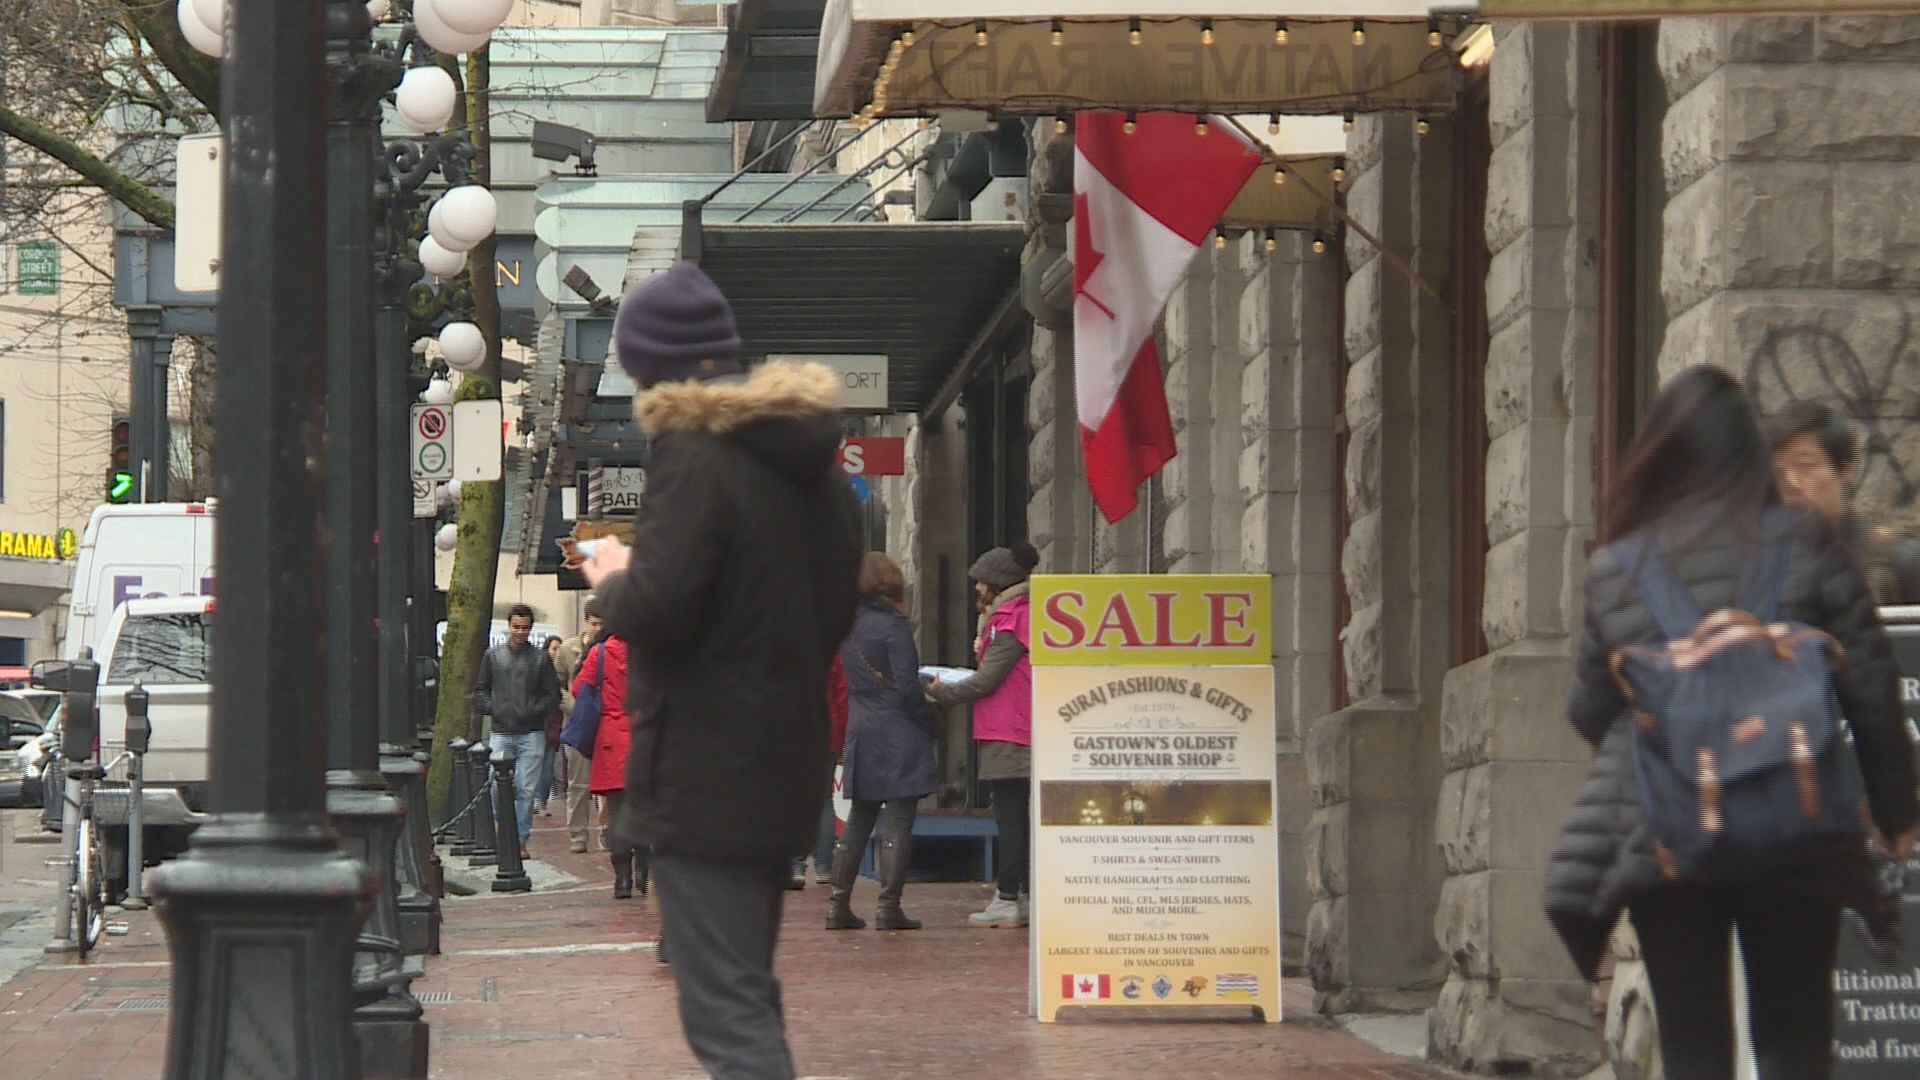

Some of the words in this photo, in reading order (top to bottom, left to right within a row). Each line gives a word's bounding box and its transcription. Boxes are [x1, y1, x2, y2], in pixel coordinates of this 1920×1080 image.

[20, 262, 52, 274] STREET
[838, 371, 881, 389] ORT
[1042, 591, 1256, 648] SALE
[1058, 686, 1107, 723] SURAJ
[1107, 675, 1187, 699] FASHIONS
[1190, 682, 1202, 699] &
[1206, 687, 1253, 722] GIFTS
[1073, 736, 1170, 750] GASTOWN'S
[1173, 736, 1237, 750] OLDEST
[1089, 752, 1174, 767] SOUVENIR
[1177, 752, 1222, 767] SHOP
[1060, 835, 1119, 844] VANCOUVER
[1121, 835, 1172, 844] SOUVENIR
[1174, 835, 1196, 844] AND
[1198, 835, 1220, 844] GIFT
[1223, 835, 1255, 844] ITEMS
[1092, 855, 1136, 864] T-SHIRTS
[1138, 855, 1146, 864] &
[1148, 855, 1221, 864] SWEAT-SHIRTS
[1064, 875, 1101, 885] NATIVE
[1103, 875, 1174, 885] HANDICRAFTS
[1176, 875, 1197, 885] AND
[1199, 875, 1251, 885] CLOTHING
[1064, 896, 1109, 905] OFFICIAL
[1159, 896, 1180, 905] MLS
[1182, 896, 1222, 906] JERSIES,
[1224, 896, 1252, 906] HATS,
[1112, 906, 1133, 915] AND
[1136, 906, 1165, 915] MUCH
[1108, 933, 1131, 942] BEST
[1134, 933, 1165, 942] DEALS
[1167, 933, 1178, 942] IN
[1180, 933, 1209, 942] TOWN
[1048, 946, 1091, 956] LARGEST
[1093, 946, 1146, 956] SELECTION
[1148, 946, 1161, 956] OF
[1163, 946, 1217, 956] SOUVENIRS
[1219, 946, 1240, 956] AND
[1242, 946, 1269, 956] GIFTS
[1124, 958, 1134, 967] IN
[1136, 958, 1195, 967] VANCOUVER
[1832, 1039, 1878, 1059] ood
